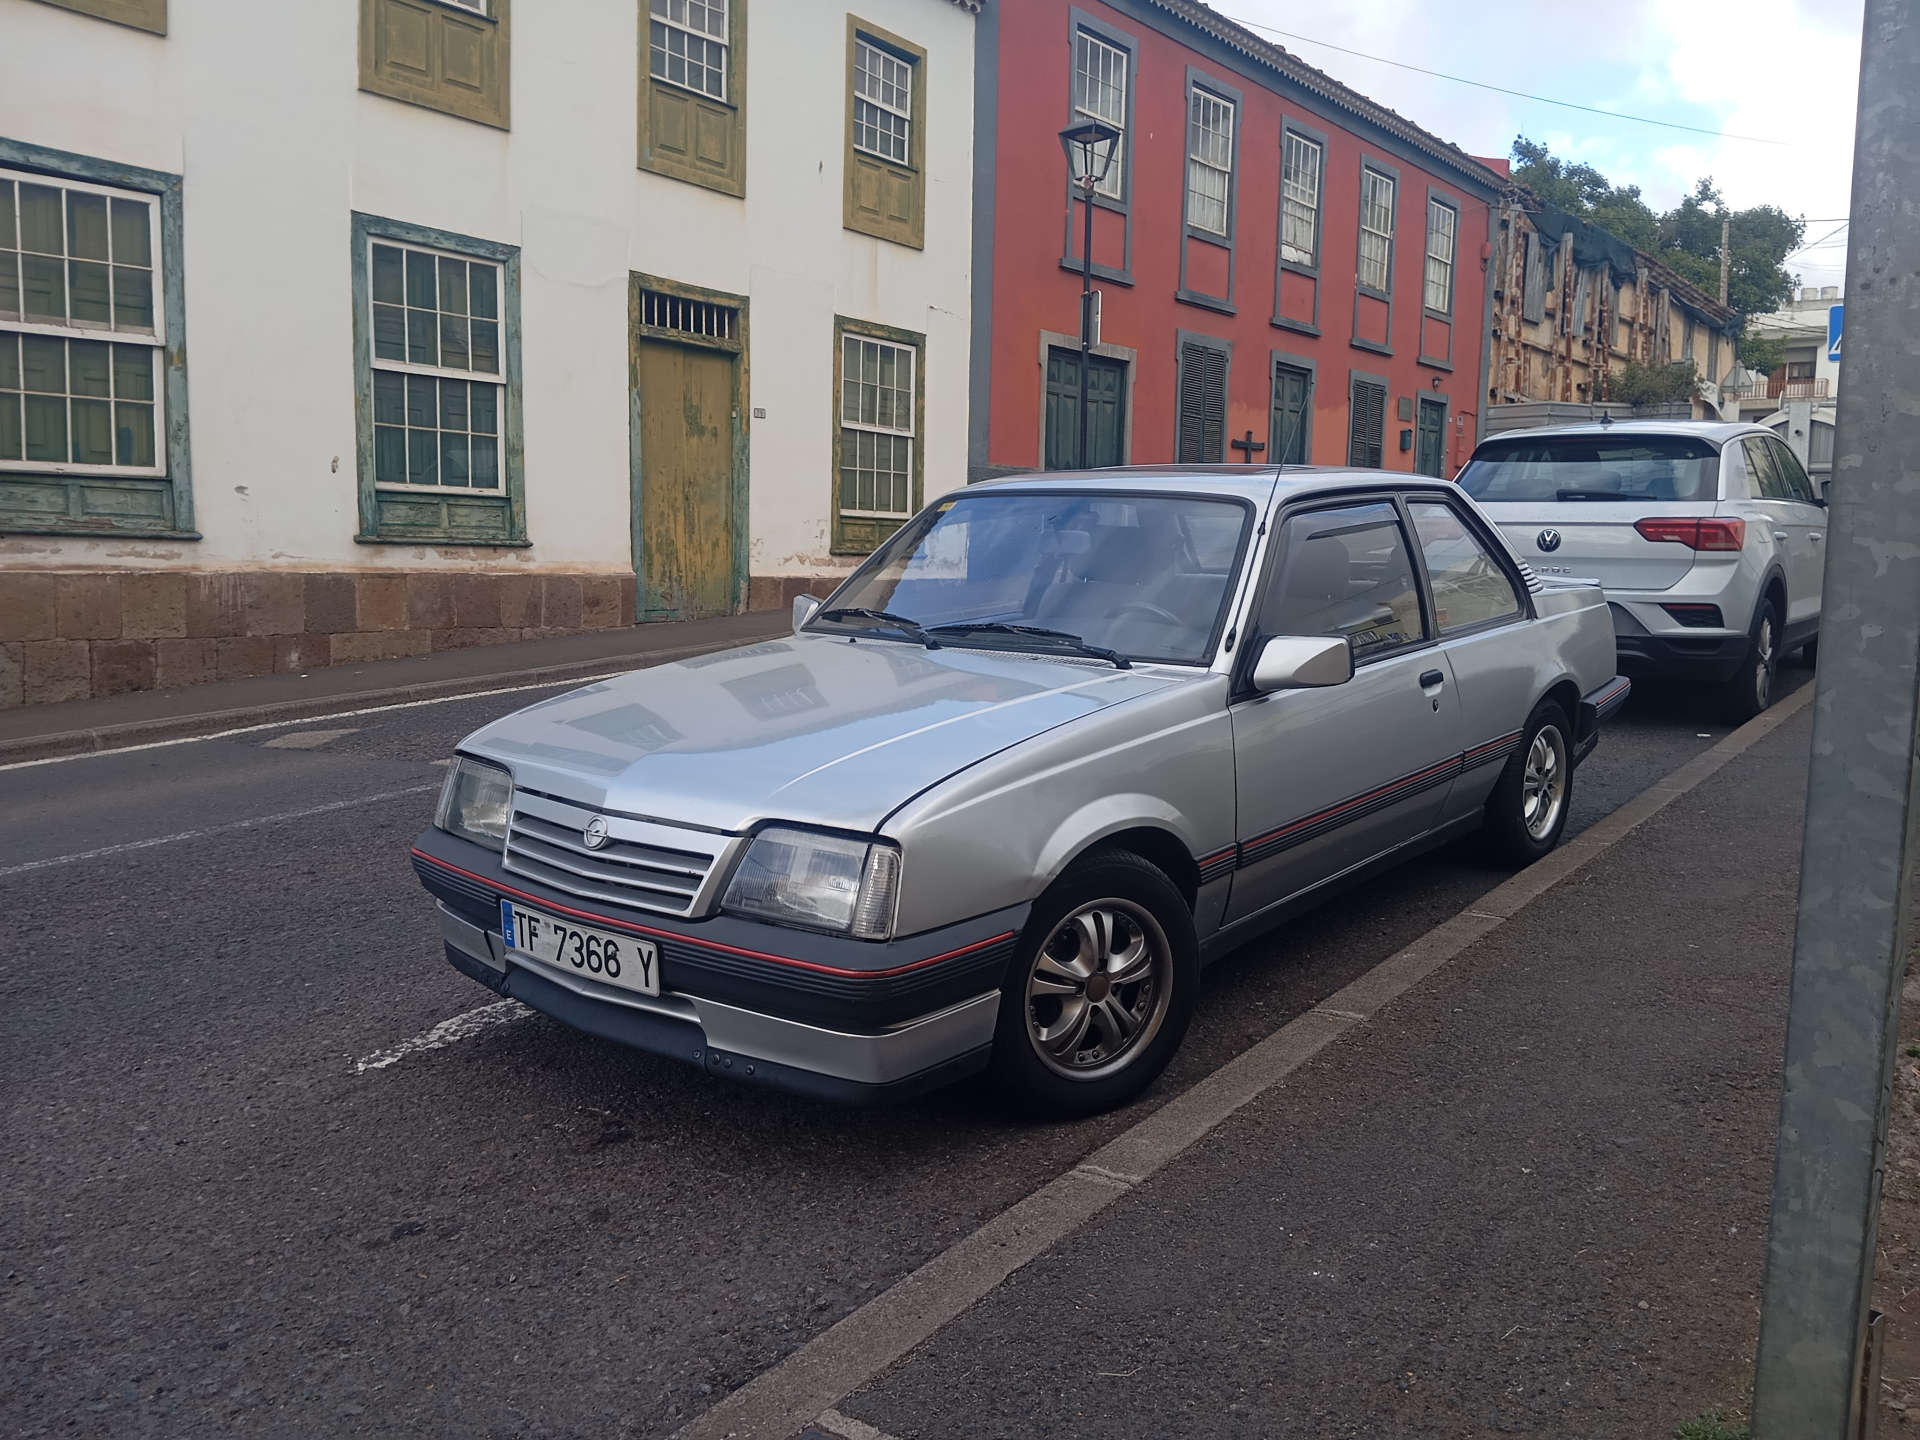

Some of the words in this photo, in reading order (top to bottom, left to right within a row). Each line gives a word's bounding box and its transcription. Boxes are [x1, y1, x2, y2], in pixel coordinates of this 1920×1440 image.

[506, 930, 512, 940] E
[514, 911, 540, 951] TF
[553, 924, 621, 978] 7366
[637, 947, 653, 988] Y
